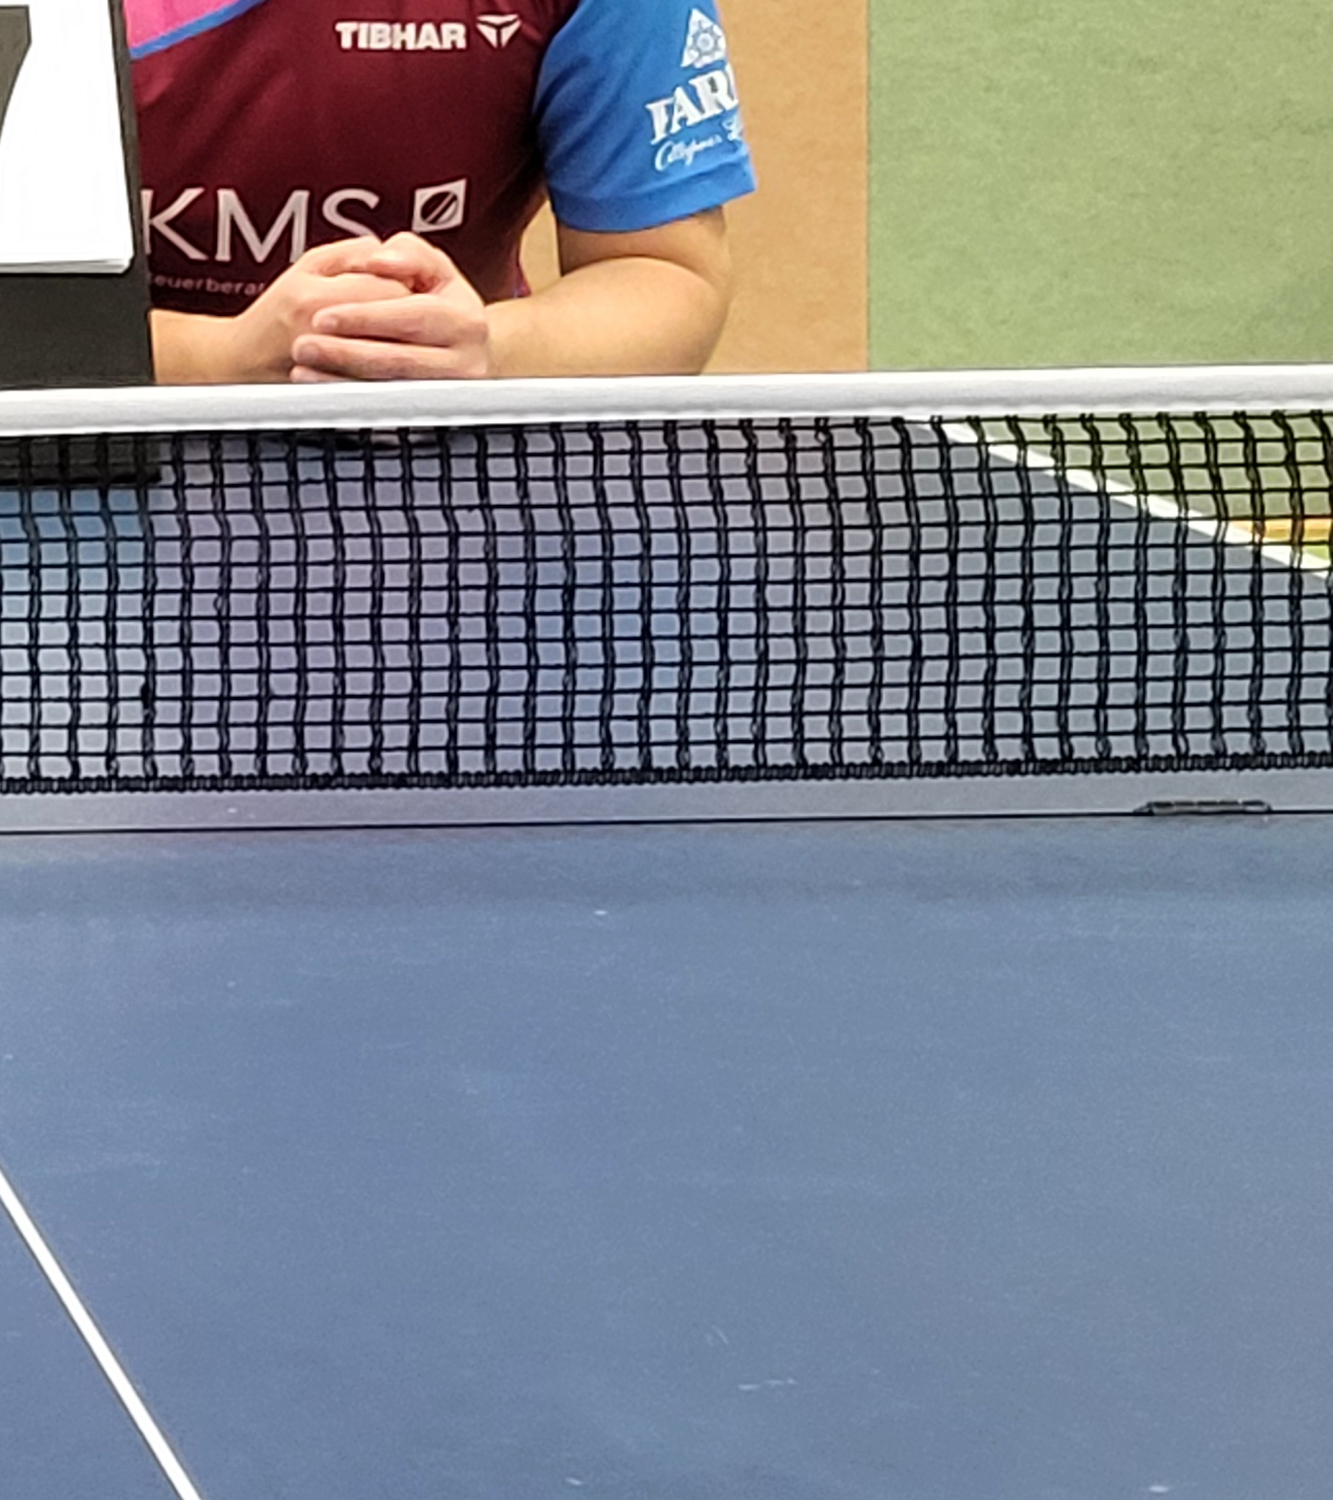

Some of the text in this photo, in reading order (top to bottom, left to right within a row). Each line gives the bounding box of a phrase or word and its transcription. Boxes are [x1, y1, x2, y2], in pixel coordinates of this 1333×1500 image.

[335, 22, 467, 50] TIBHAR
[645, 61, 739, 146] FAR
[140, 187, 380, 263] KMS
